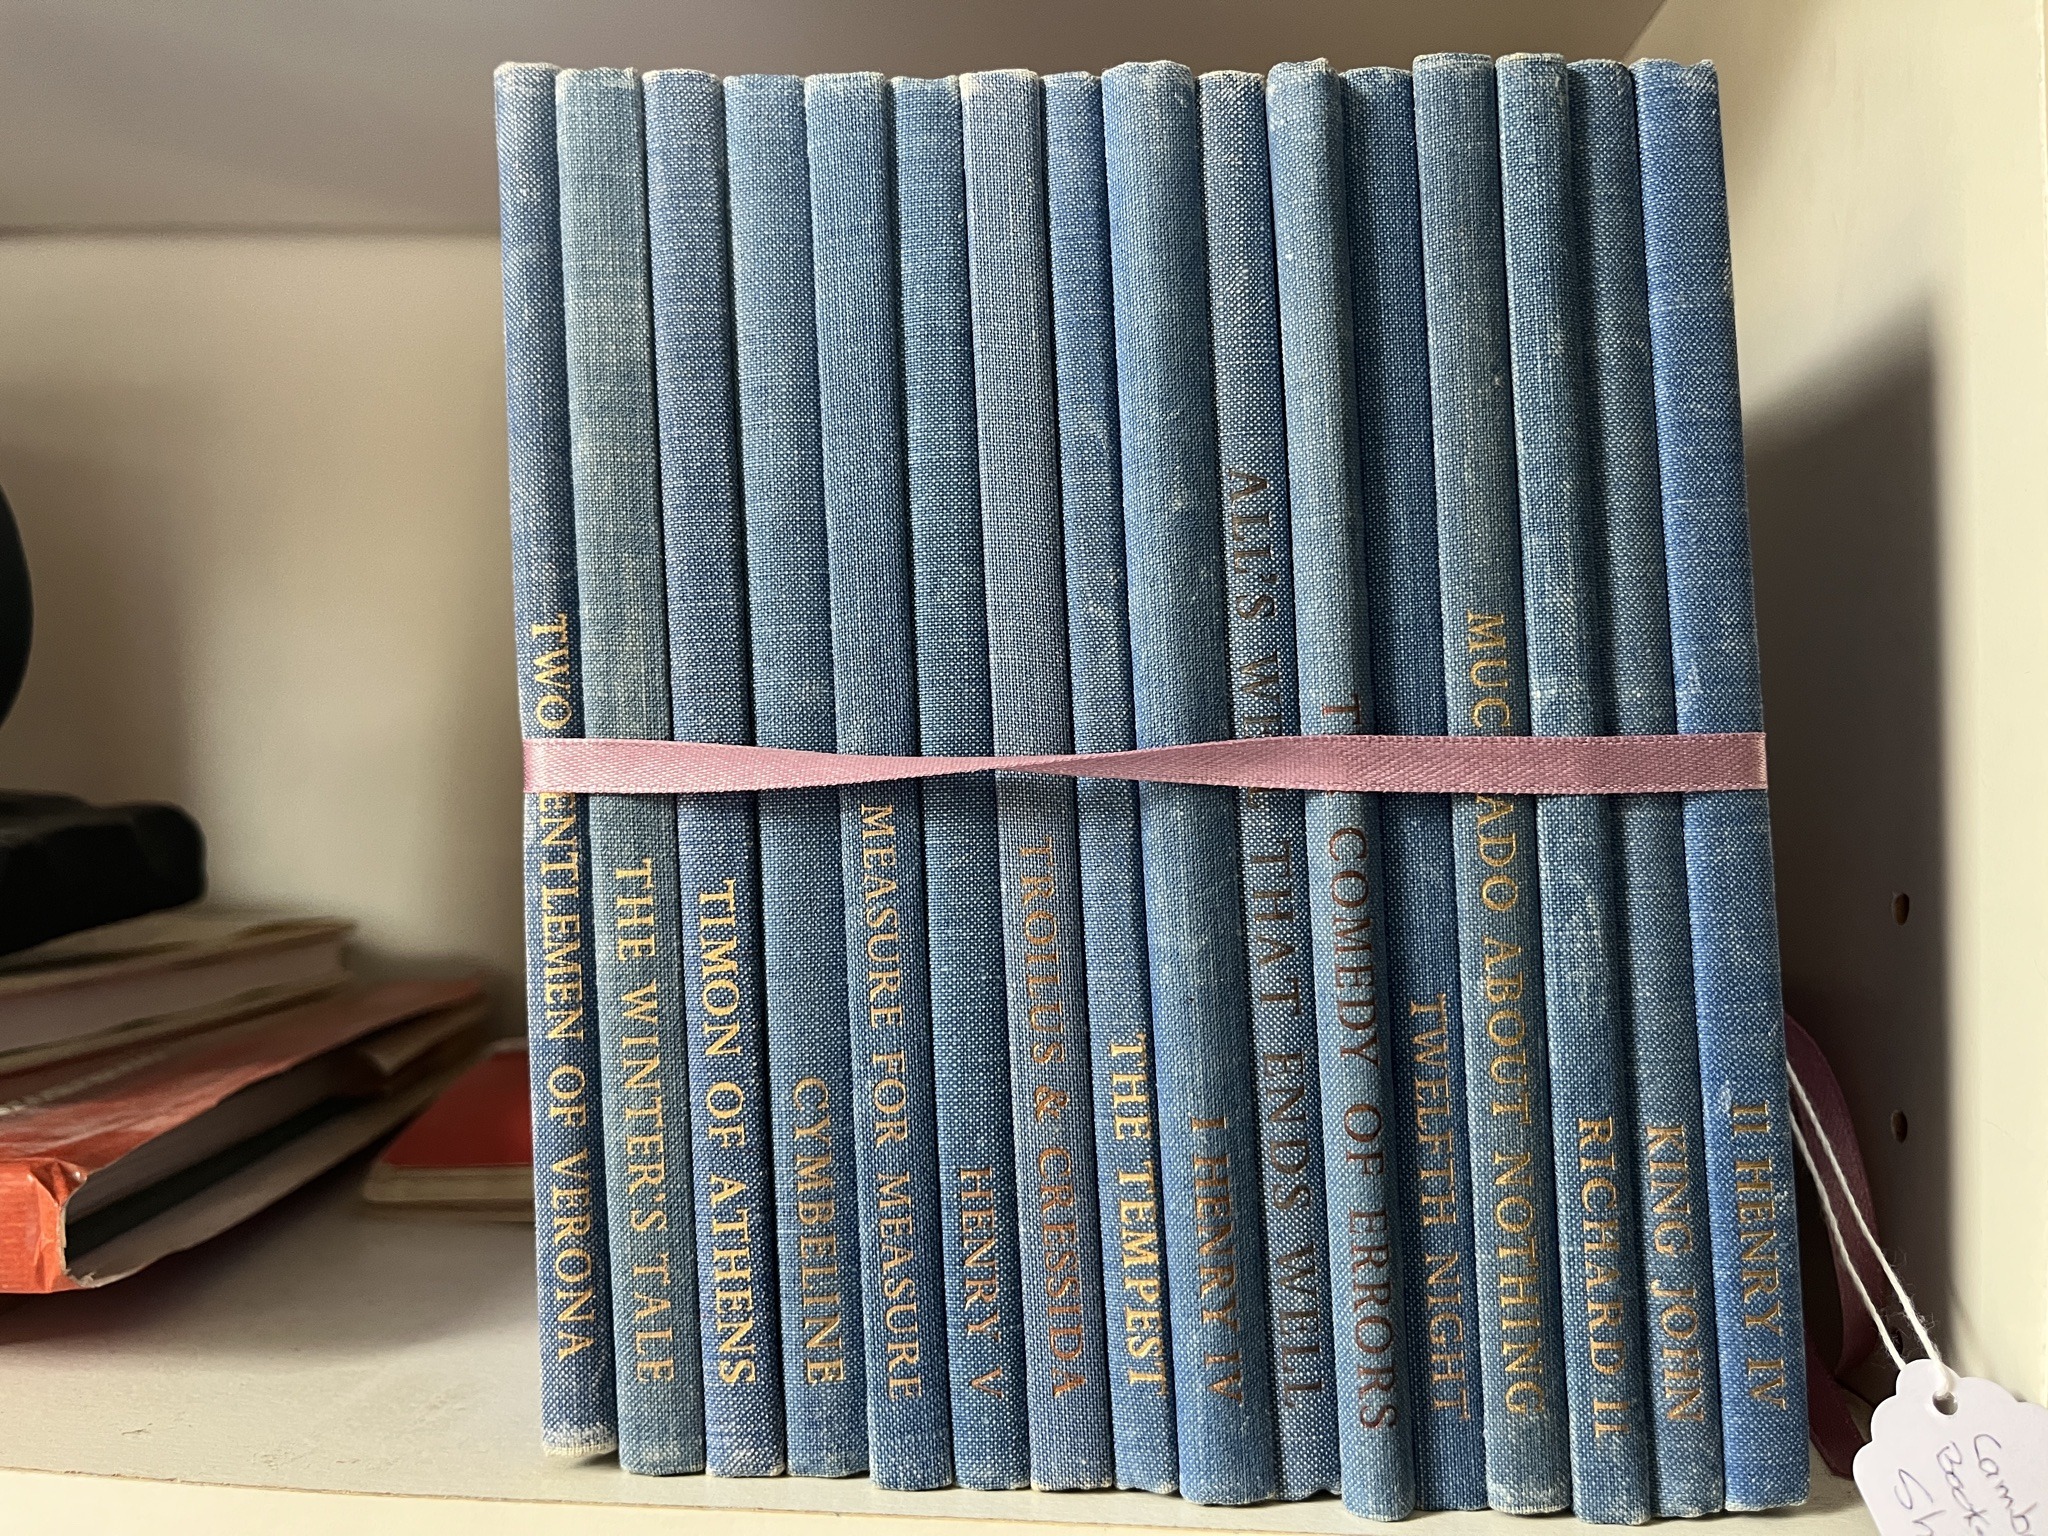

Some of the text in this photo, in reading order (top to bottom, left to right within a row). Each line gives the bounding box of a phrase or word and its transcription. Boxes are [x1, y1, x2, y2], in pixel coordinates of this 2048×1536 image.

[531, 613, 595, 1361] TWO ENTLEMEN OF VERONA
[1228, 467, 1323, 1408] ALL'S WEL THAT ENDS WELL
[1328, 827, 1380, 1070] COMEDY
[1466, 609, 1545, 1414] MUC ADO ABOUT NOTHING
[615, 858, 674, 1382] THE WINTER'S TALE
[699, 878, 756, 1384] TIMON OF ATHENS
[793, 1077, 844, 1387] CYMBELINE
[861, 803, 923, 1401] MEASURE FOR MEASURE
[1020, 836, 1086, 1397] TROILUS & CRESSIDA
[1109, 1032, 1167, 1396] THE TEMPEST
[1343, 1103, 1384, 1175] OF
[1409, 993, 1470, 1421] TWELFTH NIGHT
[1731, 1100, 1787, 1410] II HENRY IV
[959, 1166, 1004, 1400] HENRY V
[1190, 1115, 1243, 1406] I HENRY IV
[1350, 1209, 1397, 1429] ERRORS
[1577, 1116, 1631, 1438] RICHARD II
[1647, 1124, 1704, 1422] KING JOHN
[1936, 1440, 1990, 1536] Book
[1973, 1433, 2038, 1536] Camb
